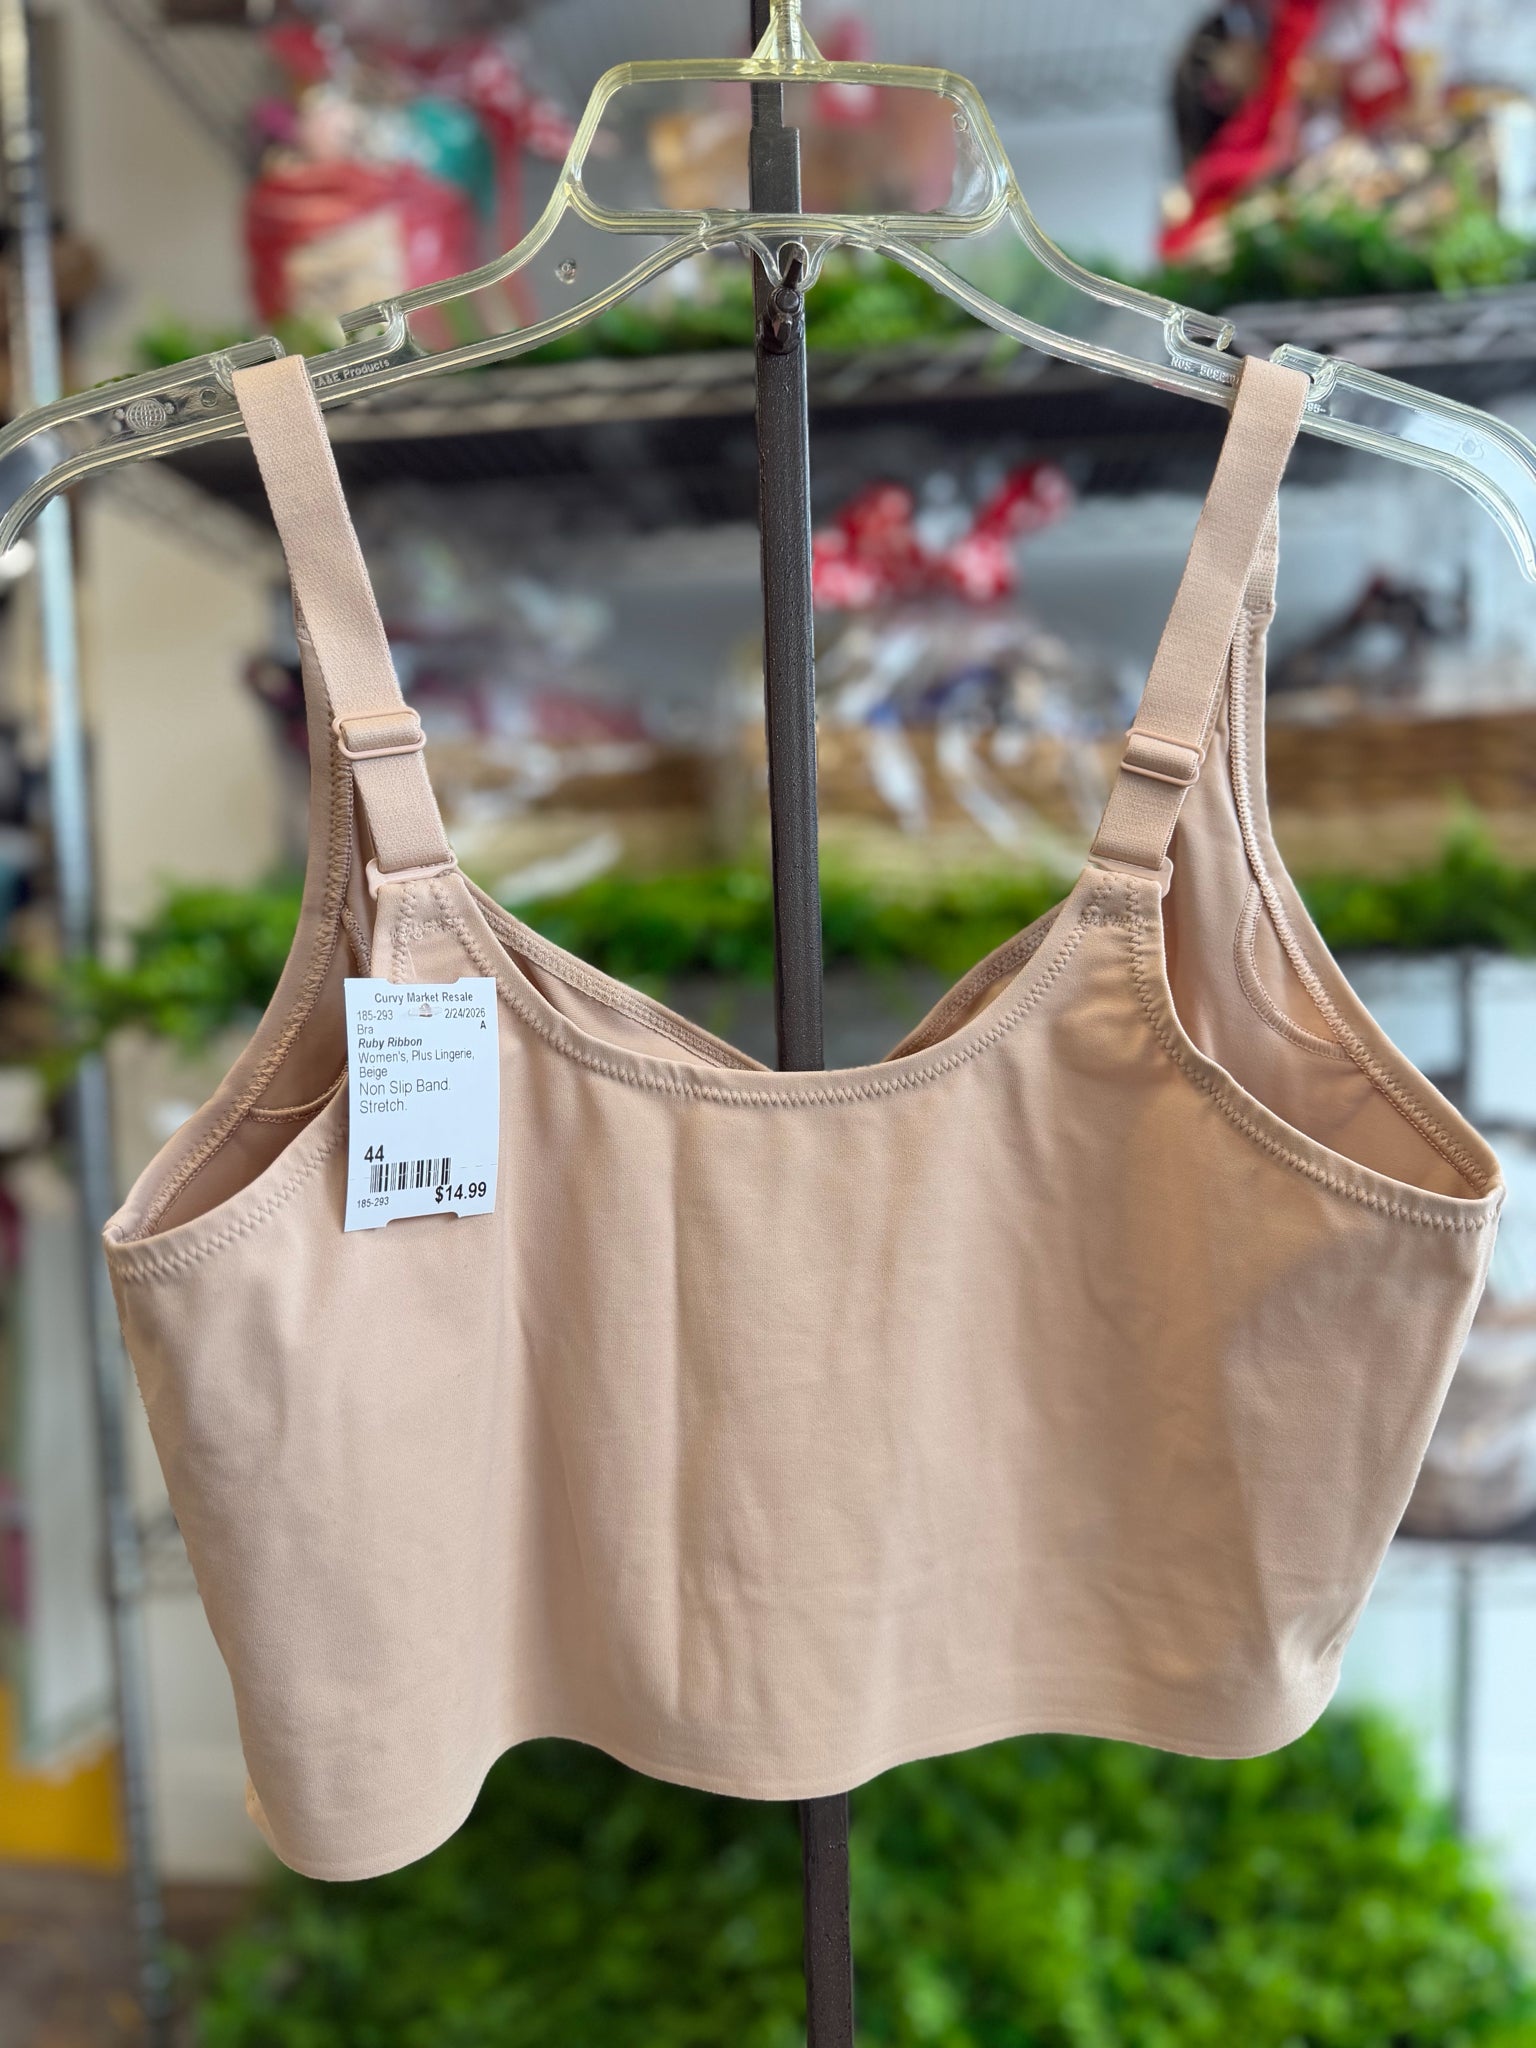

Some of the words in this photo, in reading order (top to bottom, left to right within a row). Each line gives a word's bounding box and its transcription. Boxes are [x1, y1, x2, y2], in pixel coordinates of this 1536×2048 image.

[343, 360, 390, 379] Products
[374, 993, 404, 1005] Curvy
[407, 992, 439, 1003] Market
[442, 991, 473, 1002] Resale
[357, 1009, 394, 1021] 185-293
[444, 1007, 486, 1019] 2/24/2026
[357, 1024, 374, 1035] Bra
[480, 1020, 487, 1029] A
[358, 1038, 385, 1051] Ruby
[387, 1037, 423, 1048] Ribbon
[358, 1051, 409, 1064] Women's,
[411, 1049, 433, 1061] Plus
[435, 1048, 475, 1062] Lingerie,
[359, 1066, 388, 1080] Beige
[360, 1082, 385, 1096] Non
[389, 1080, 413, 1096] Slip
[416, 1077, 451, 1093] Band.
[359, 1098, 408, 1114] Stretch.
[364, 1144, 385, 1163] 44
[435, 1181, 487, 1204] $14.99
[357, 1196, 389, 1209] 185-293
